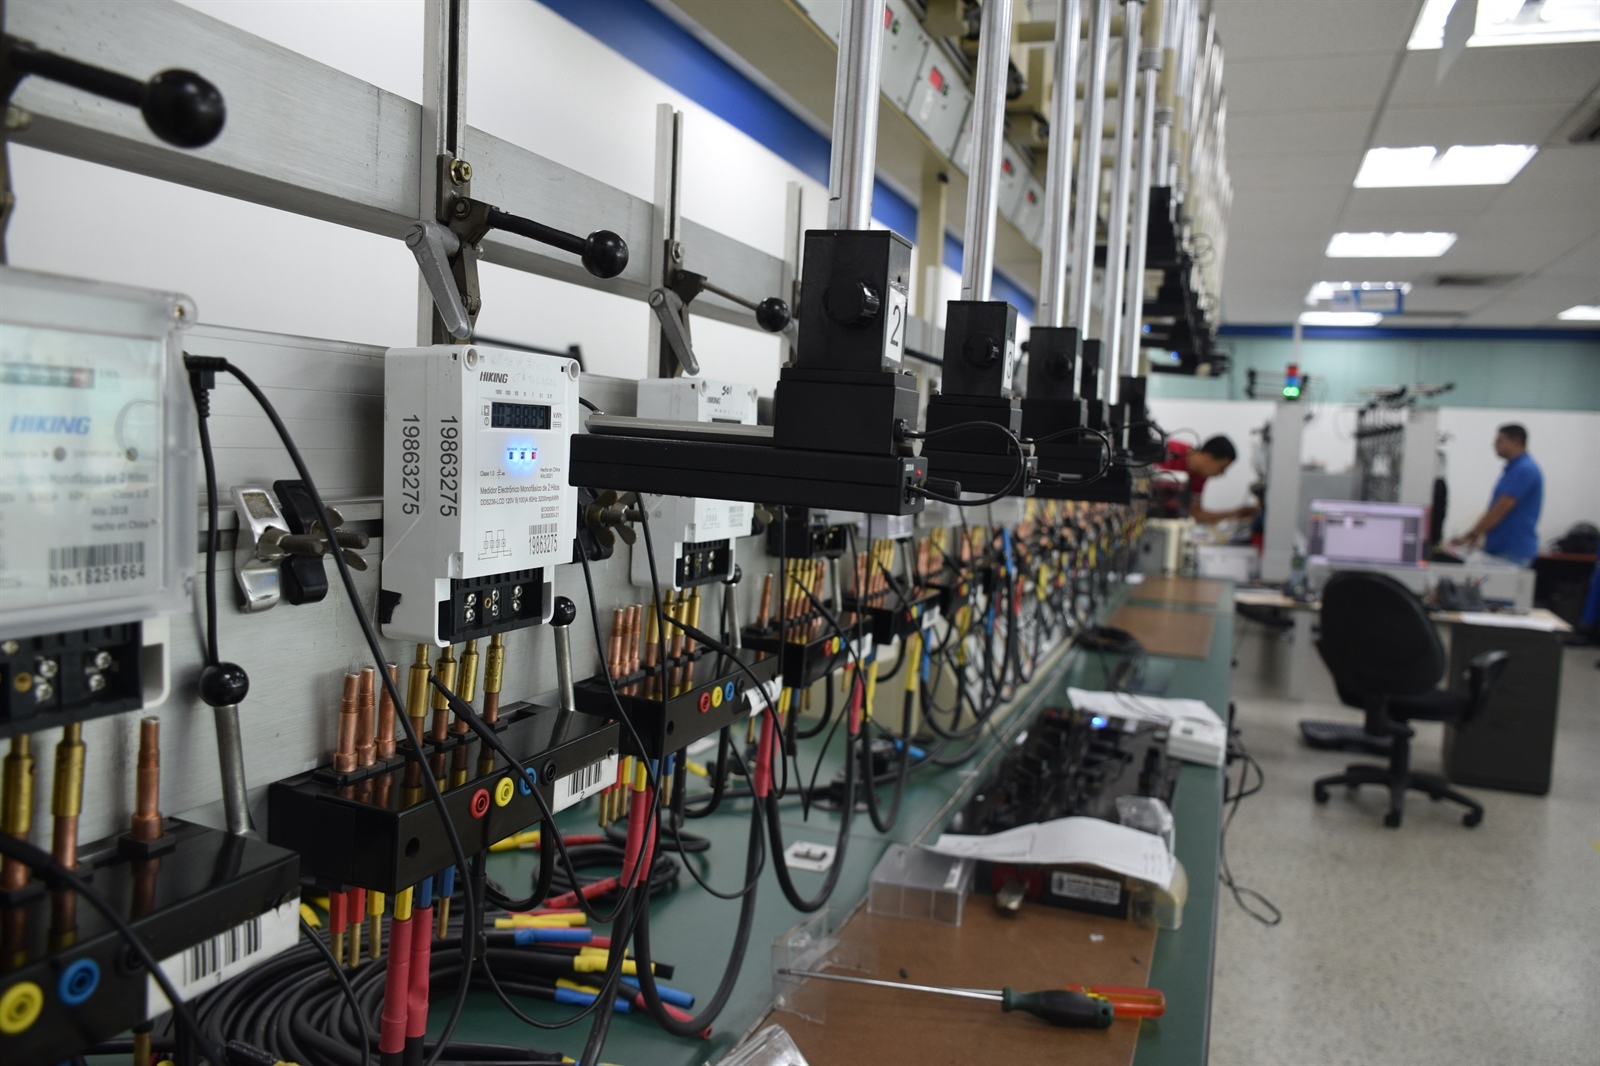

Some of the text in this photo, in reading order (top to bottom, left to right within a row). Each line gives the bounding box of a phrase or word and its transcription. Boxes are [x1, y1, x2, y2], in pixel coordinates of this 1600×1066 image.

[890, 305, 901, 347] 2
[1006, 351, 1012, 379] 3
[480, 371, 508, 384] HIKING
[9, 414, 92, 435] HIKING
[402, 414, 420, 514] 19863275
[440, 416, 458, 516] 19863275
[498, 485, 520, 494] Electrónico
[520, 484, 541, 492] Monofásico
[529, 534, 557, 555] 19863275
[580, 791, 585, 800] 2
